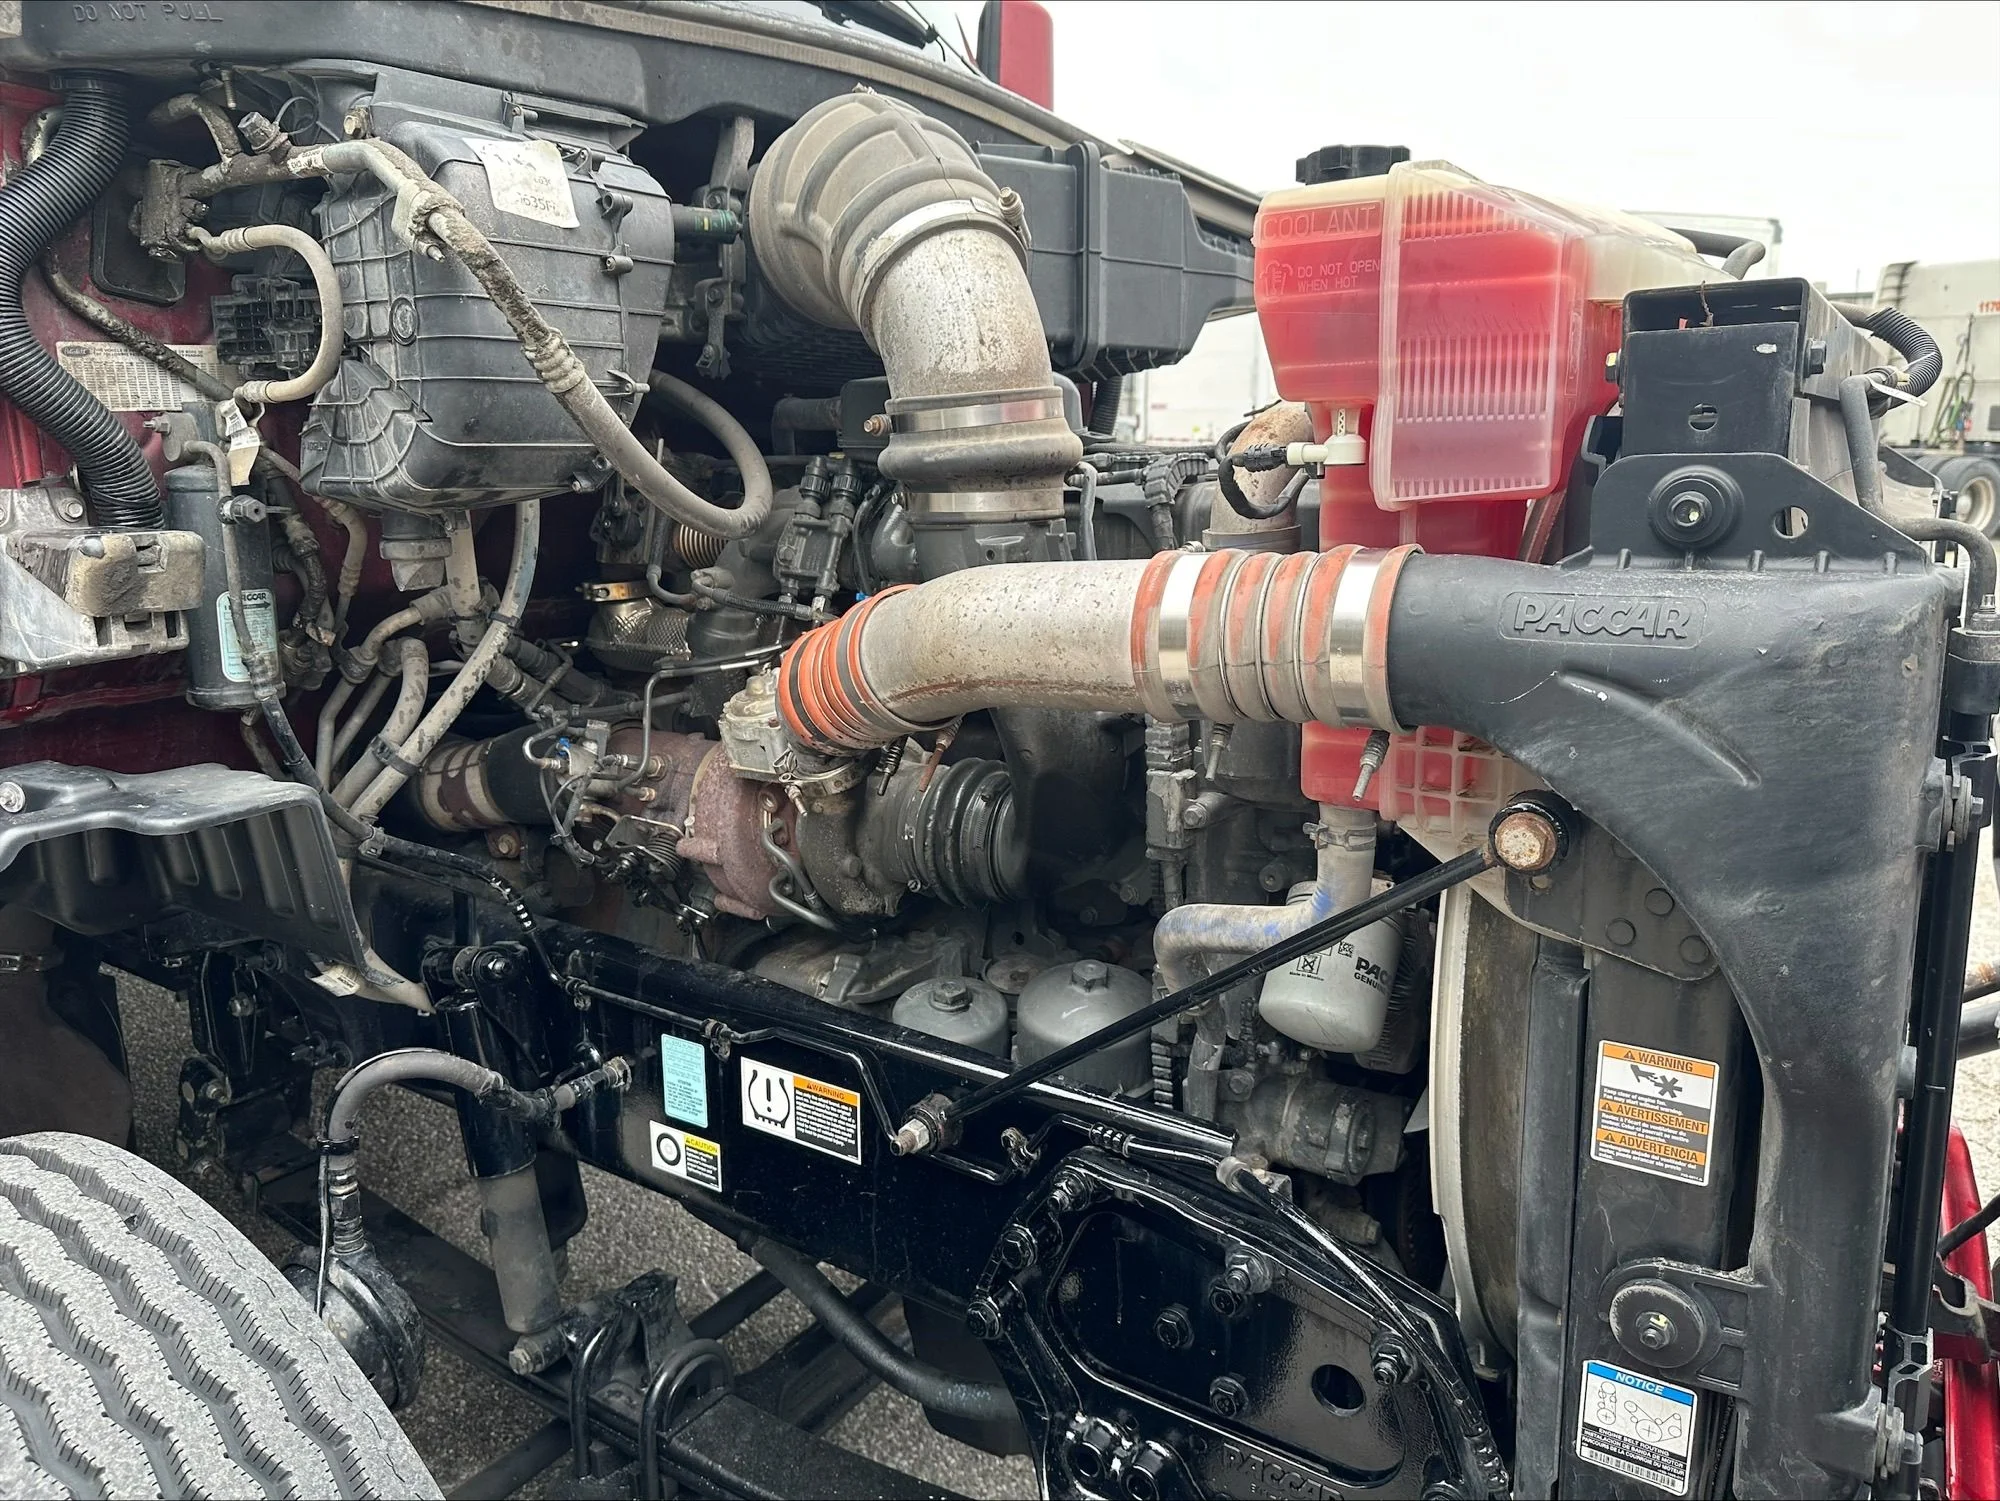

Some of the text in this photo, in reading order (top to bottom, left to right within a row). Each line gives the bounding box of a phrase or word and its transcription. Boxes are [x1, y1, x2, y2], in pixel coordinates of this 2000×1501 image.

[73, 2, 224, 22] DO NOT PULL
[1263, 205, 1376, 240] COOLANT
[1297, 259, 1380, 279] DO NOT OPEN
[1297, 275, 1358, 293] WHEN HOT
[1513, 596, 1690, 639] PACCAR
[1355, 956, 1393, 986] PAC
[1638, 1052, 1693, 1073] WARNING
[812, 1084, 845, 1100] WARNING
[1616, 1104, 1707, 1134] AVERTISSEMENT
[691, 1138, 718, 1153] CAUTION
[1618, 1135, 1699, 1162] ADVERTENCIA
[1615, 1371, 1665, 1396] NOTICE
[1623, 1436, 1640, 1447] BELT
[1639, 1441, 1670, 1457] ROUTING
